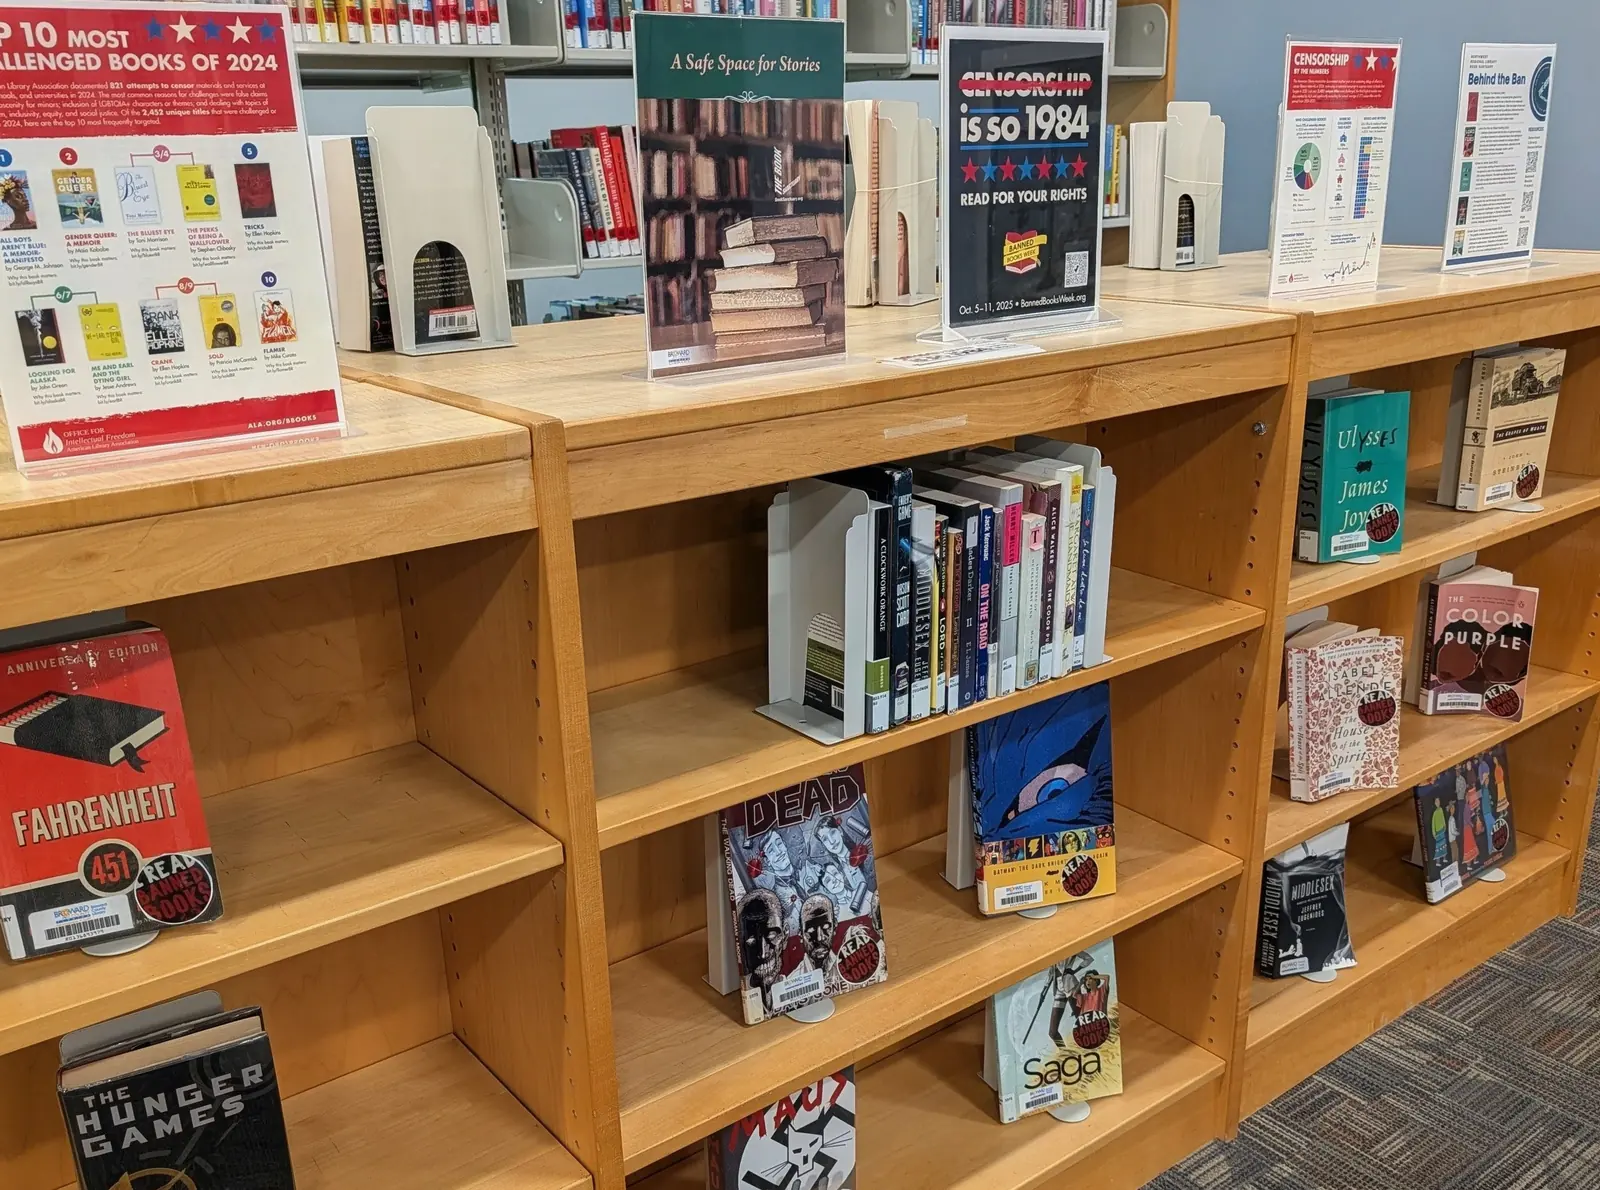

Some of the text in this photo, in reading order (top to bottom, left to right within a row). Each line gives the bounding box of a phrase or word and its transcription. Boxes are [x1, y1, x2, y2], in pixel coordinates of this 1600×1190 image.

[19, 21, 58, 48] 10
[68, 29, 130, 49] MOST
[0, 52, 279, 72] LLENGED BOOKS OF 2024
[670, 53, 821, 76] A Safe Space for Stories
[1294, 52, 1349, 67] CENSORSHIP
[32, 82, 69, 90] Association
[70, 81, 109, 90] documented
[110, 81, 123, 90] 821
[126, 82, 159, 91] attempts
[223, 81, 235, 89] and
[236, 82, 259, 90] services
[961, 72, 1091, 97] CENSORSHIP
[1467, 73, 1526, 85] Behind the Ban
[188, 90, 219, 99] challenges
[142, 108, 210, 117] 2,452 unique titles
[960, 103, 1090, 142] is so 1984
[65, 149, 169, 160] 2 3/4
[57, 176, 93, 185] GENDER
[58, 183, 94, 192] QUEER
[960, 188, 1088, 207] READ FOR YOUR RIGHTS
[65, 233, 93, 241] GENDER
[73, 239, 101, 247] MEMOIR
[188, 239, 230, 247] WALLFLOWER
[1008, 239, 1035, 253] BANNED
[4, 256, 44, 265] MANIFESTO
[264, 276, 275, 284] 10
[959, 293, 1088, 315] Oct. 5-11, 2025 BannedBooksWeek.org
[146, 331, 183, 342] ELLEN
[149, 340, 185, 351] HOPKINS
[118, 362, 134, 370] EARL
[150, 358, 174, 366] CRANK
[28, 369, 61, 379] LOOKING
[30, 376, 57, 385] ALASKA
[63, 427, 105, 438] OFFICE FOR
[248, 415, 317, 430] ALA.ORG/BBOOKS
[65, 431, 136, 447] Intellectual Freedom
[1337, 480, 1389, 505] James
[1339, 510, 1369, 533] Joy
[1369, 503, 1395, 520] READ
[983, 514, 992, 562] Jack Kerouac
[966, 572, 974, 602] Darker
[914, 568, 931, 651] MIDDLESEX
[979, 583, 990, 650] ON THE ROAD
[1446, 608, 1525, 629] COLOR
[1444, 631, 1522, 651] PURPLE
[6, 642, 160, 676] ANNIVERSARY EDITION
[1319, 681, 1392, 702] ALLENDE
[1486, 684, 1512, 700] READ
[1333, 726, 1370, 741] House
[1349, 739, 1361, 748] the
[1331, 749, 1372, 770] Spirits
[12, 782, 177, 848] FAHRENHEIT
[744, 775, 861, 839] DEAD
[724, 838, 733, 876] WALKING
[1019, 864, 1031, 873] THE
[1031, 861, 1046, 871] DARK
[1064, 855, 1090, 877] READ
[91, 850, 131, 885] 451
[144, 854, 197, 884] READ
[136, 867, 205, 905] BANNED
[1291, 874, 1336, 902] MIDDLESEX
[1262, 876, 1282, 940] MIDDLESEX
[840, 936, 870, 958] READ
[1077, 1010, 1107, 1028] READ
[1023, 1051, 1103, 1090] Saga
[75, 1062, 264, 1135] HUNGER
[83, 1085, 132, 1109] THE
[80, 1094, 246, 1159] GAMES
